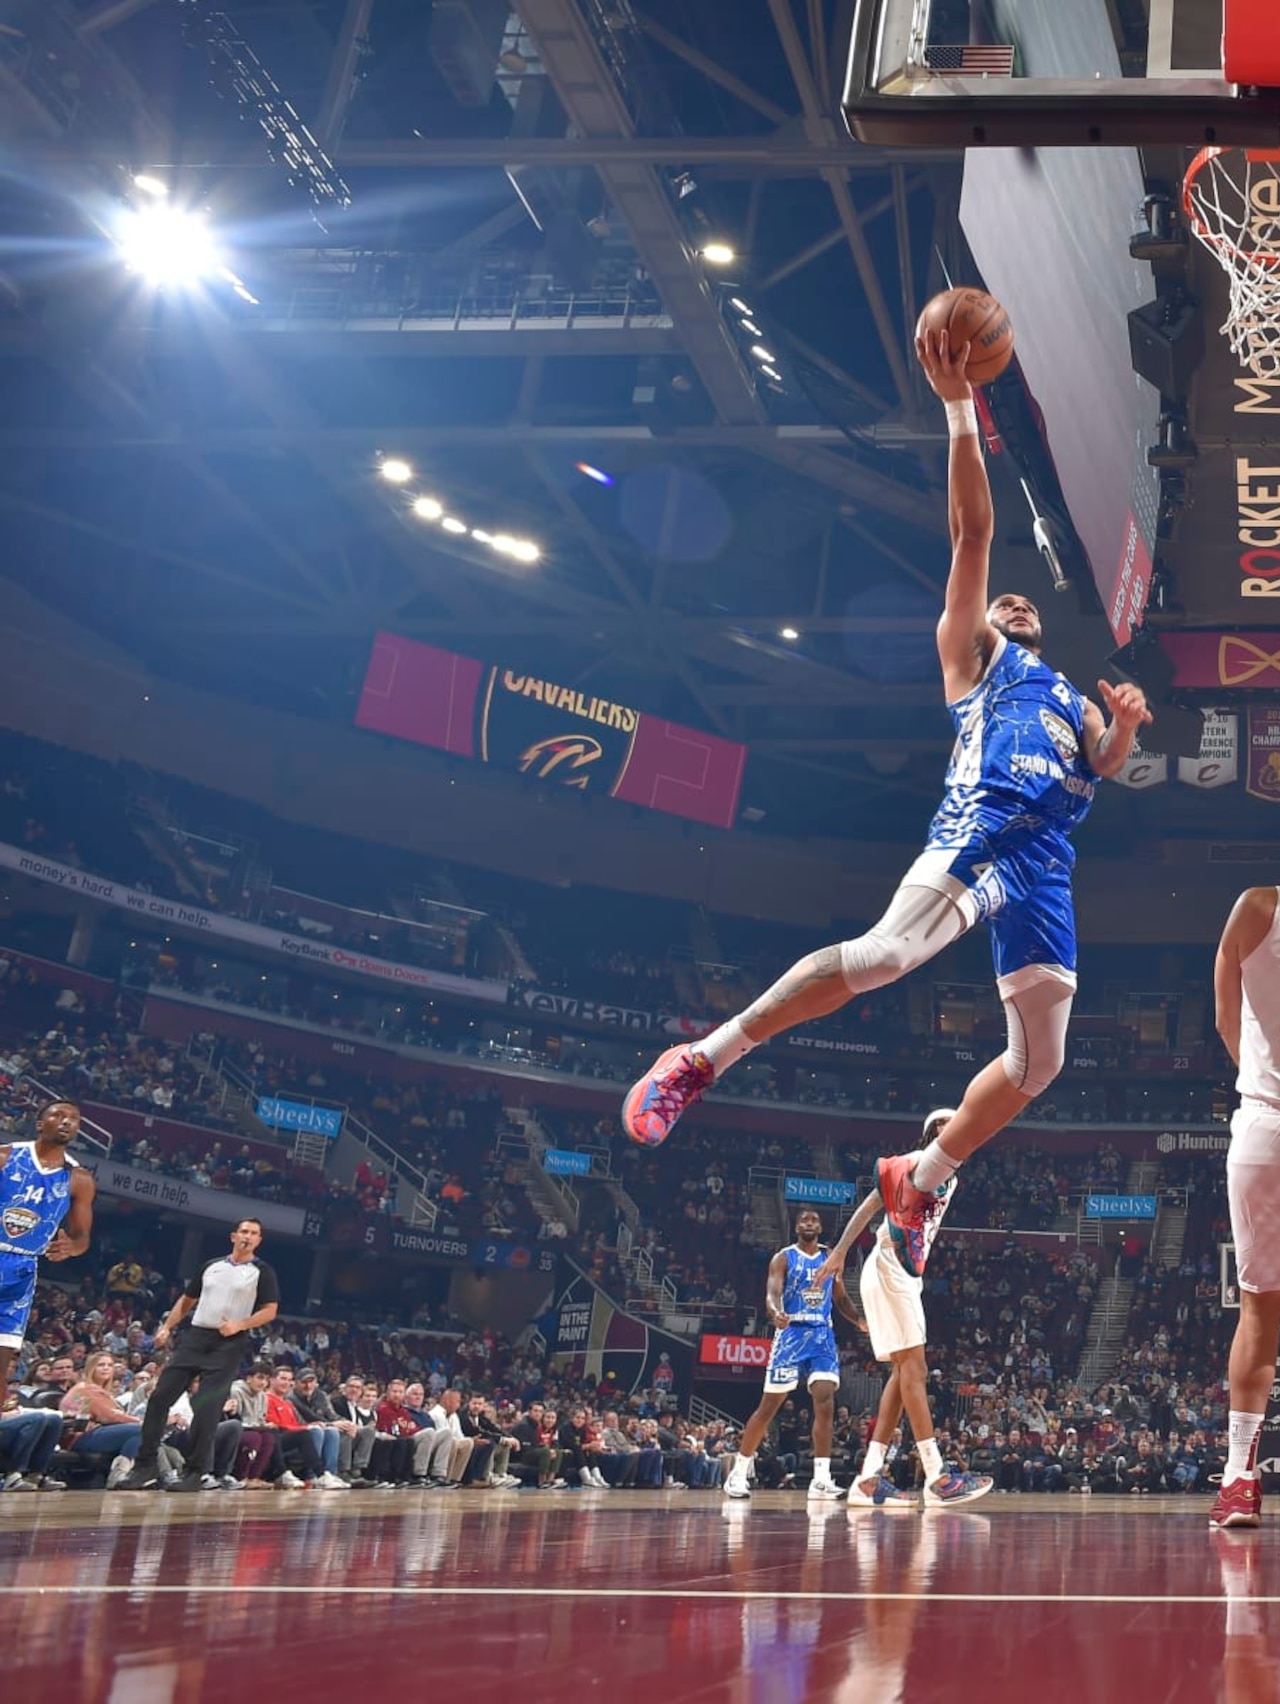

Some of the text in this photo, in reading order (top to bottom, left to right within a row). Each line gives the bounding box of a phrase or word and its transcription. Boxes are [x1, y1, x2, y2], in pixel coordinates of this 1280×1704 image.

[1204, 727, 1227, 737] TERN
[1202, 737, 1236, 748] ERENCE
[19, 856, 213, 929] money's hard. we can help.
[955, 1051, 976, 1062] TOL
[1173, 1057, 1189, 1070] 23
[259, 1099, 336, 1131] Sheely's
[1177, 1132, 1230, 1151] Huntin
[23, 1184, 44, 1205] 14
[112, 1171, 131, 1189] we
[134, 1176, 159, 1197] can
[162, 1181, 191, 1208] help.
[787, 1179, 851, 1200] Sheely's
[1088, 1197, 1153, 1215] Sheely's
[305, 1221, 320, 1236] 54
[364, 1226, 497, 1263] 5 TURNOVERS 2
[560, 1311, 591, 1326] IN THE
[557, 1325, 588, 1342] PAINT
[717, 1337, 767, 1364] fubo
